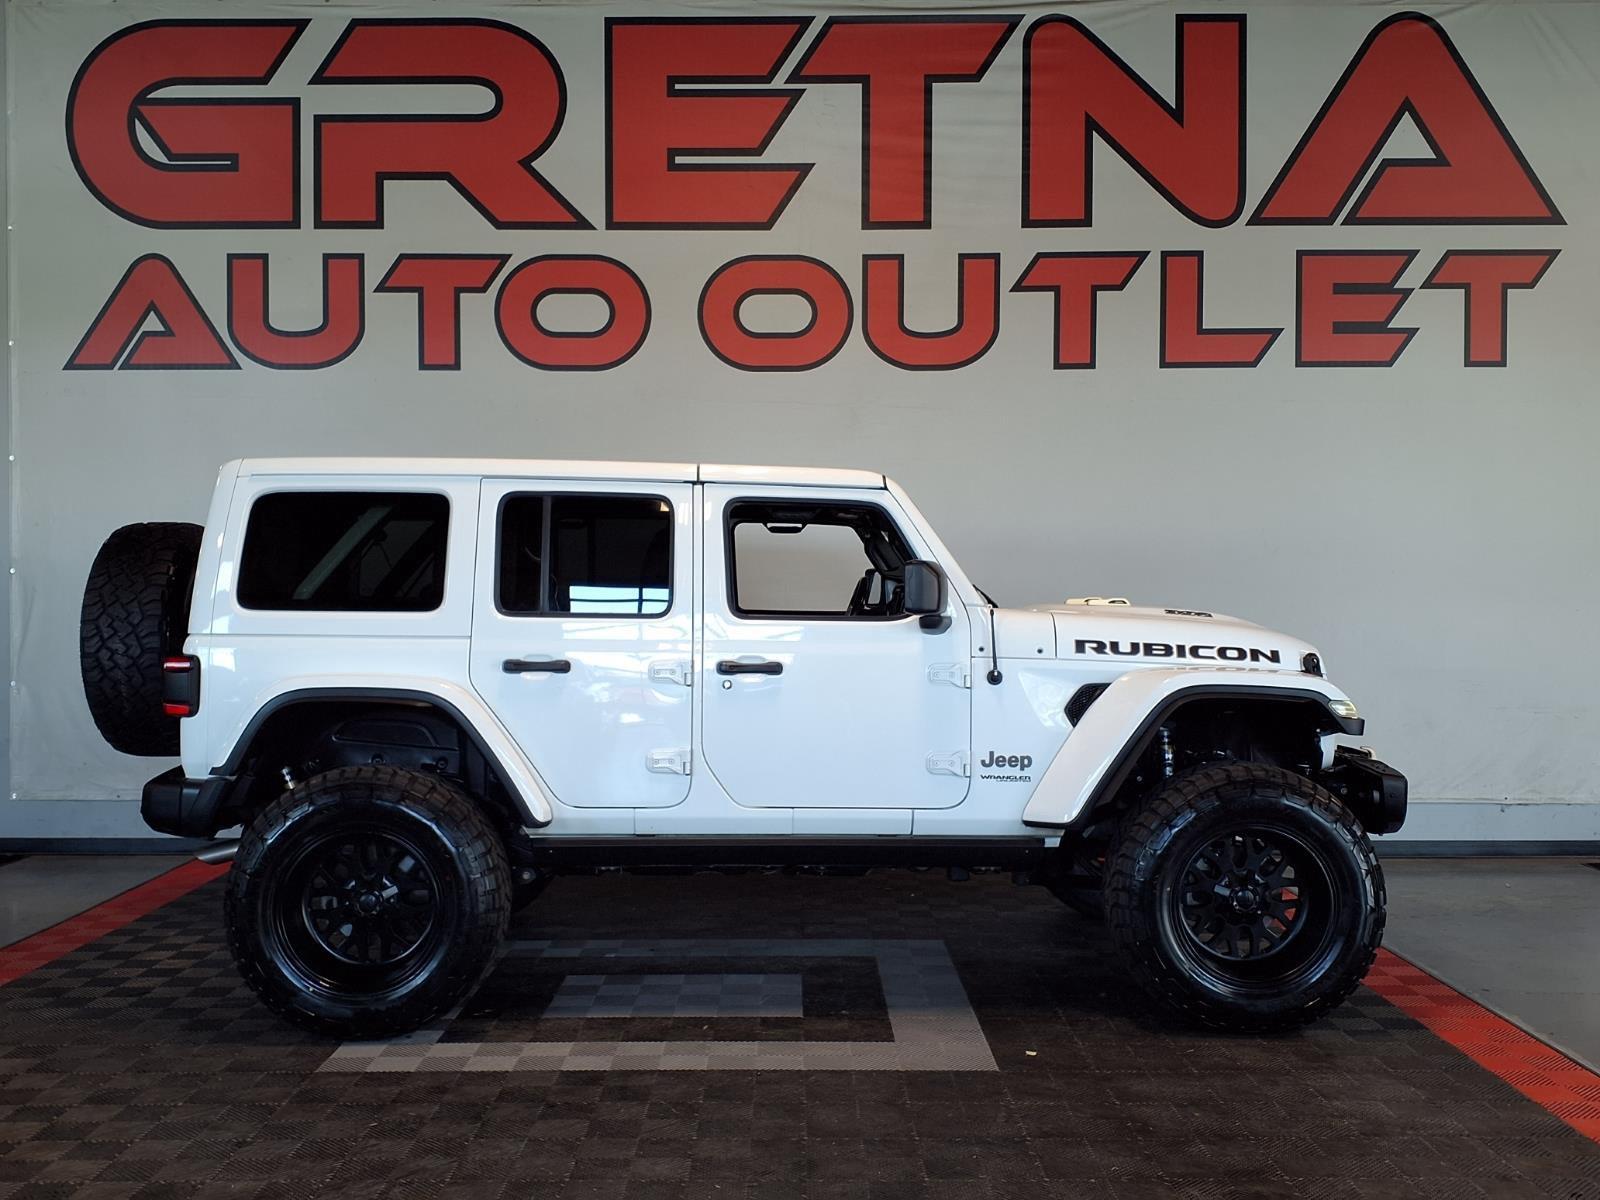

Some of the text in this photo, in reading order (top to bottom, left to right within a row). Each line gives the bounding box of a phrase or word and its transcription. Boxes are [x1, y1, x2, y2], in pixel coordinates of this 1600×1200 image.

[66, 11, 1566, 230] GRETNA
[63, 249, 1562, 371] AUTO OUTLET
[1074, 639, 1281, 664] RUBICON
[981, 751, 1033, 771] Jeep
